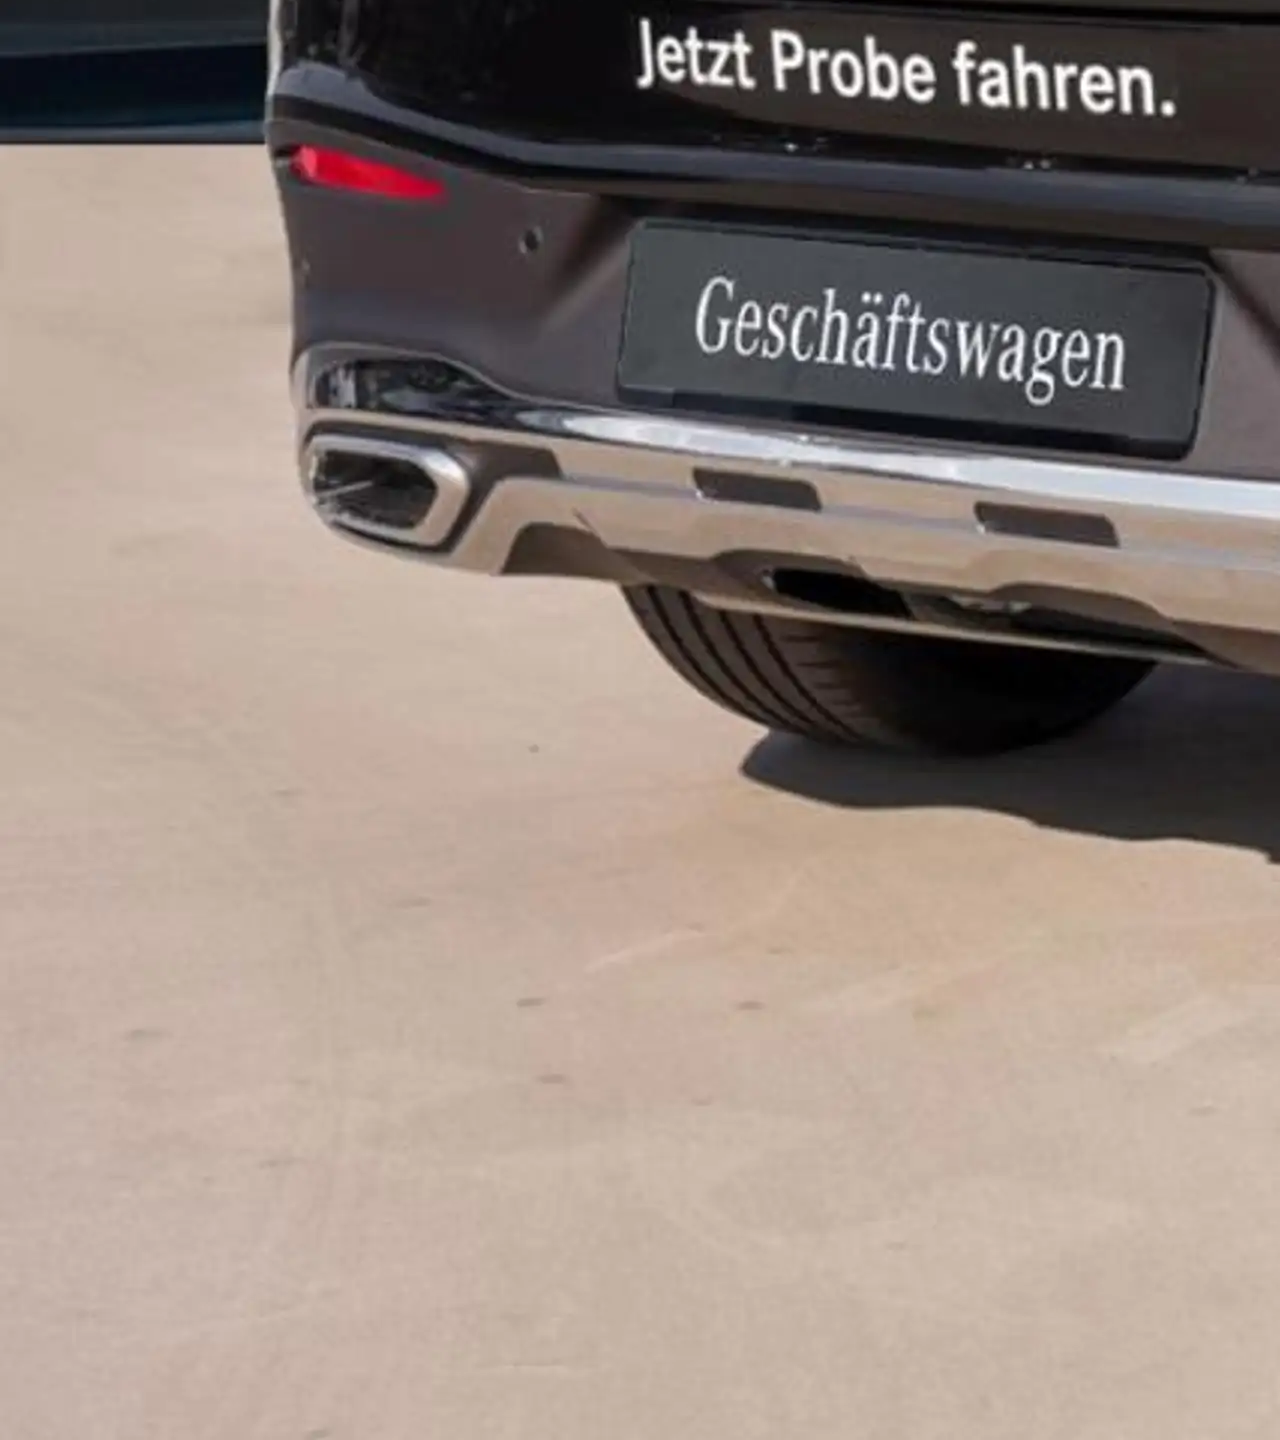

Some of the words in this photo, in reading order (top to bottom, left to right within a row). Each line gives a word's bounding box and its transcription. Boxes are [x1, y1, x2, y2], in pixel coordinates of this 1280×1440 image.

[637, 18, 756, 88] Jetzt
[771, 29, 936, 103] Probe
[953, 41, 1178, 117] fahren.
[695, 276, 1125, 406] Geschäftswagen
